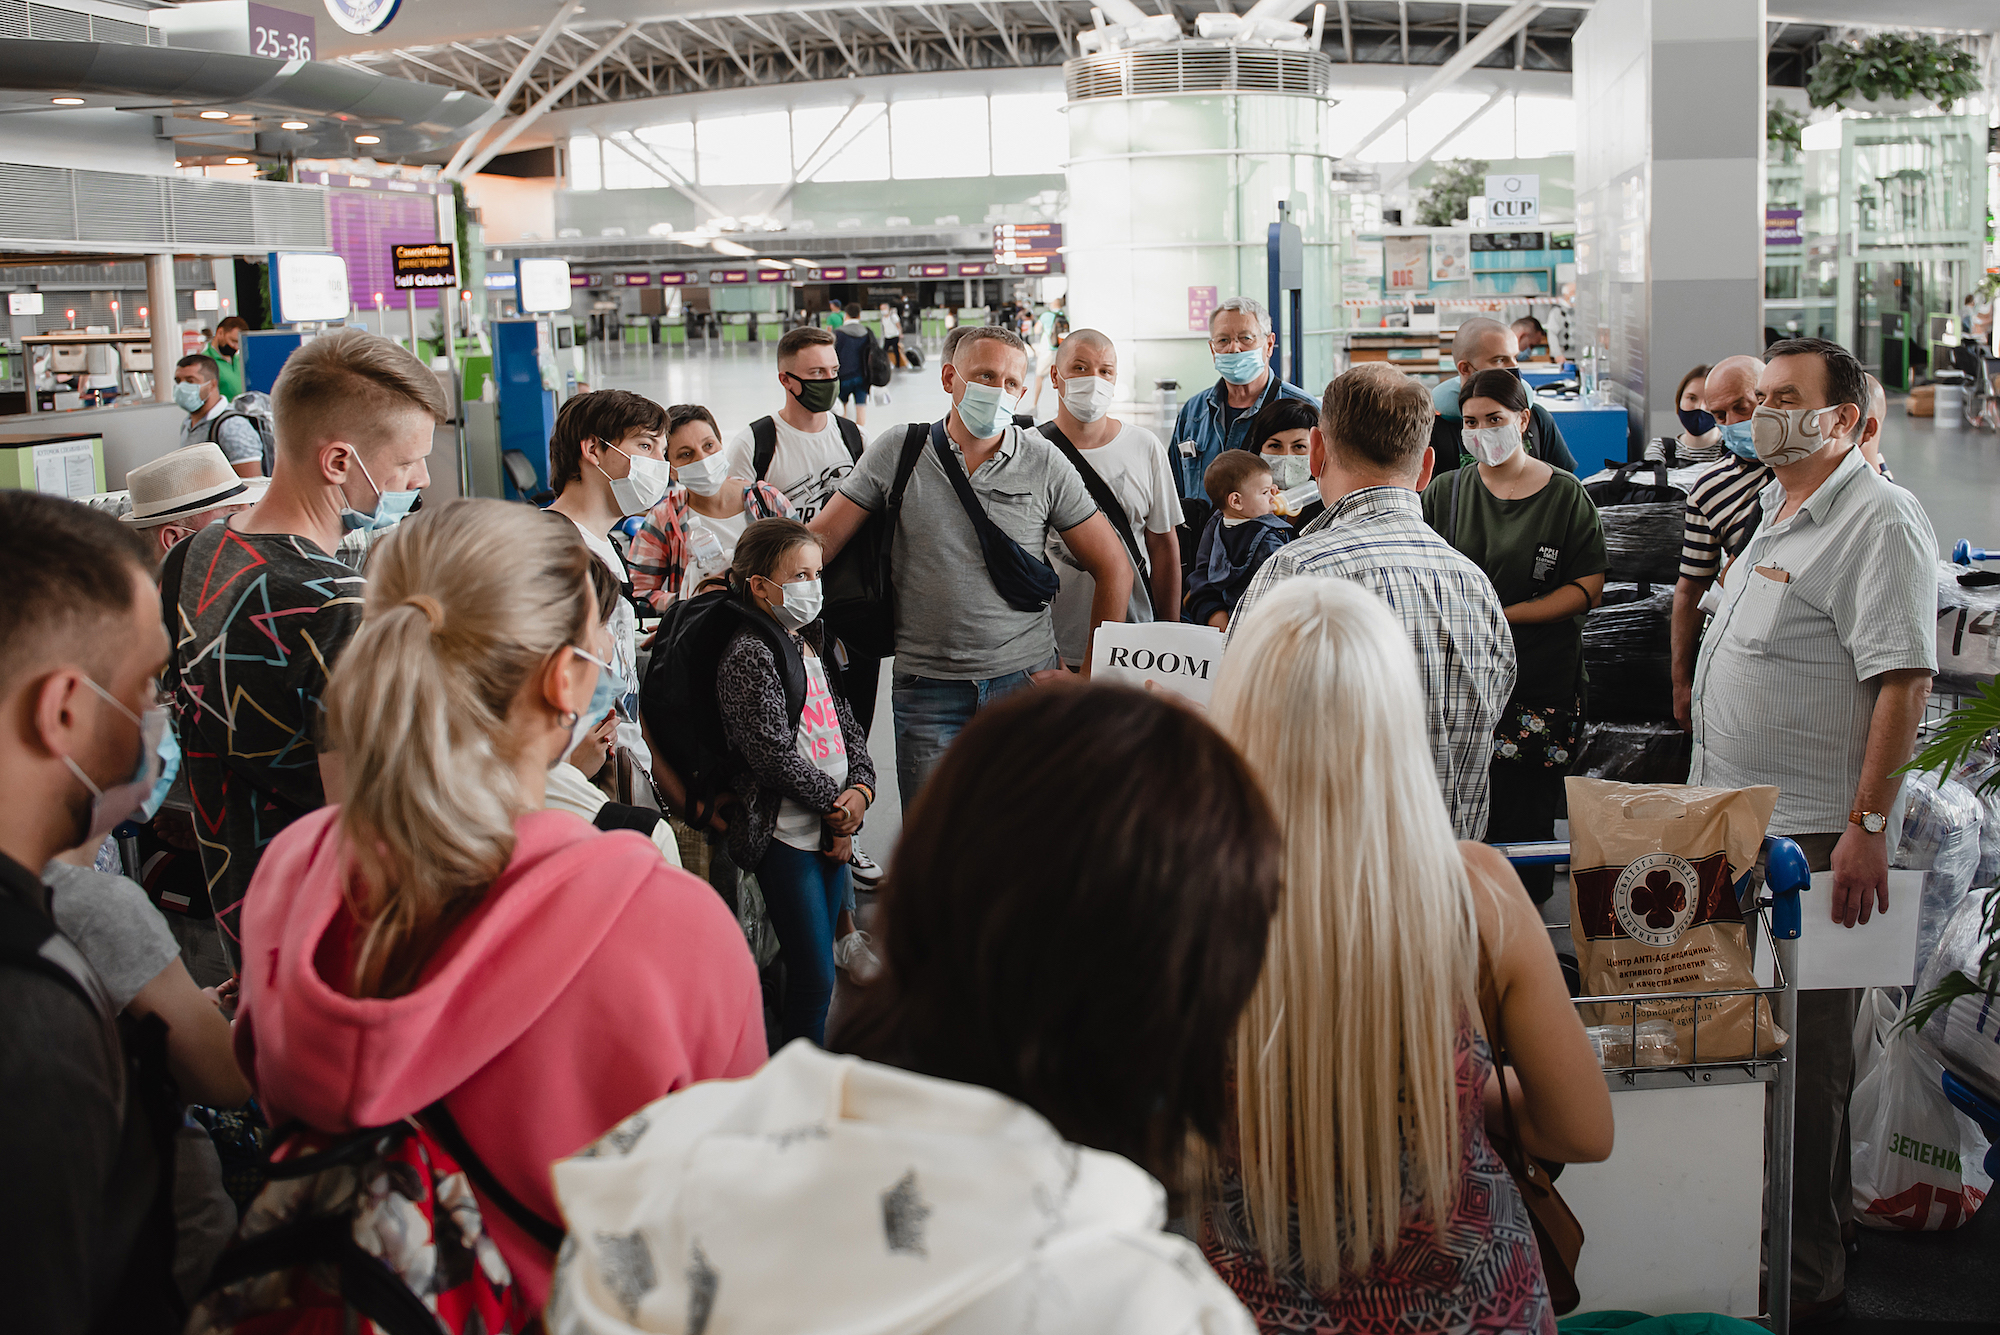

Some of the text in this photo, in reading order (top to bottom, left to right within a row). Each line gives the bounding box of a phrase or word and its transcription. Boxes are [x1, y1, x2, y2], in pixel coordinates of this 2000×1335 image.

[255, 26, 312, 62] 25-36
[1493, 200, 1533, 216] CUP
[395, 274, 414, 287] Self
[685, 272, 698, 284] 39
[1107, 646, 1212, 681] ROOM
[1633, 953, 1671, 965] ANTI-AGE
[1619, 959, 1706, 979] активного долголетия
[1636, 978, 1671, 988] качества
[1672, 973, 1700, 985] жизни
[1620, 1010, 1633, 1020] ул.
